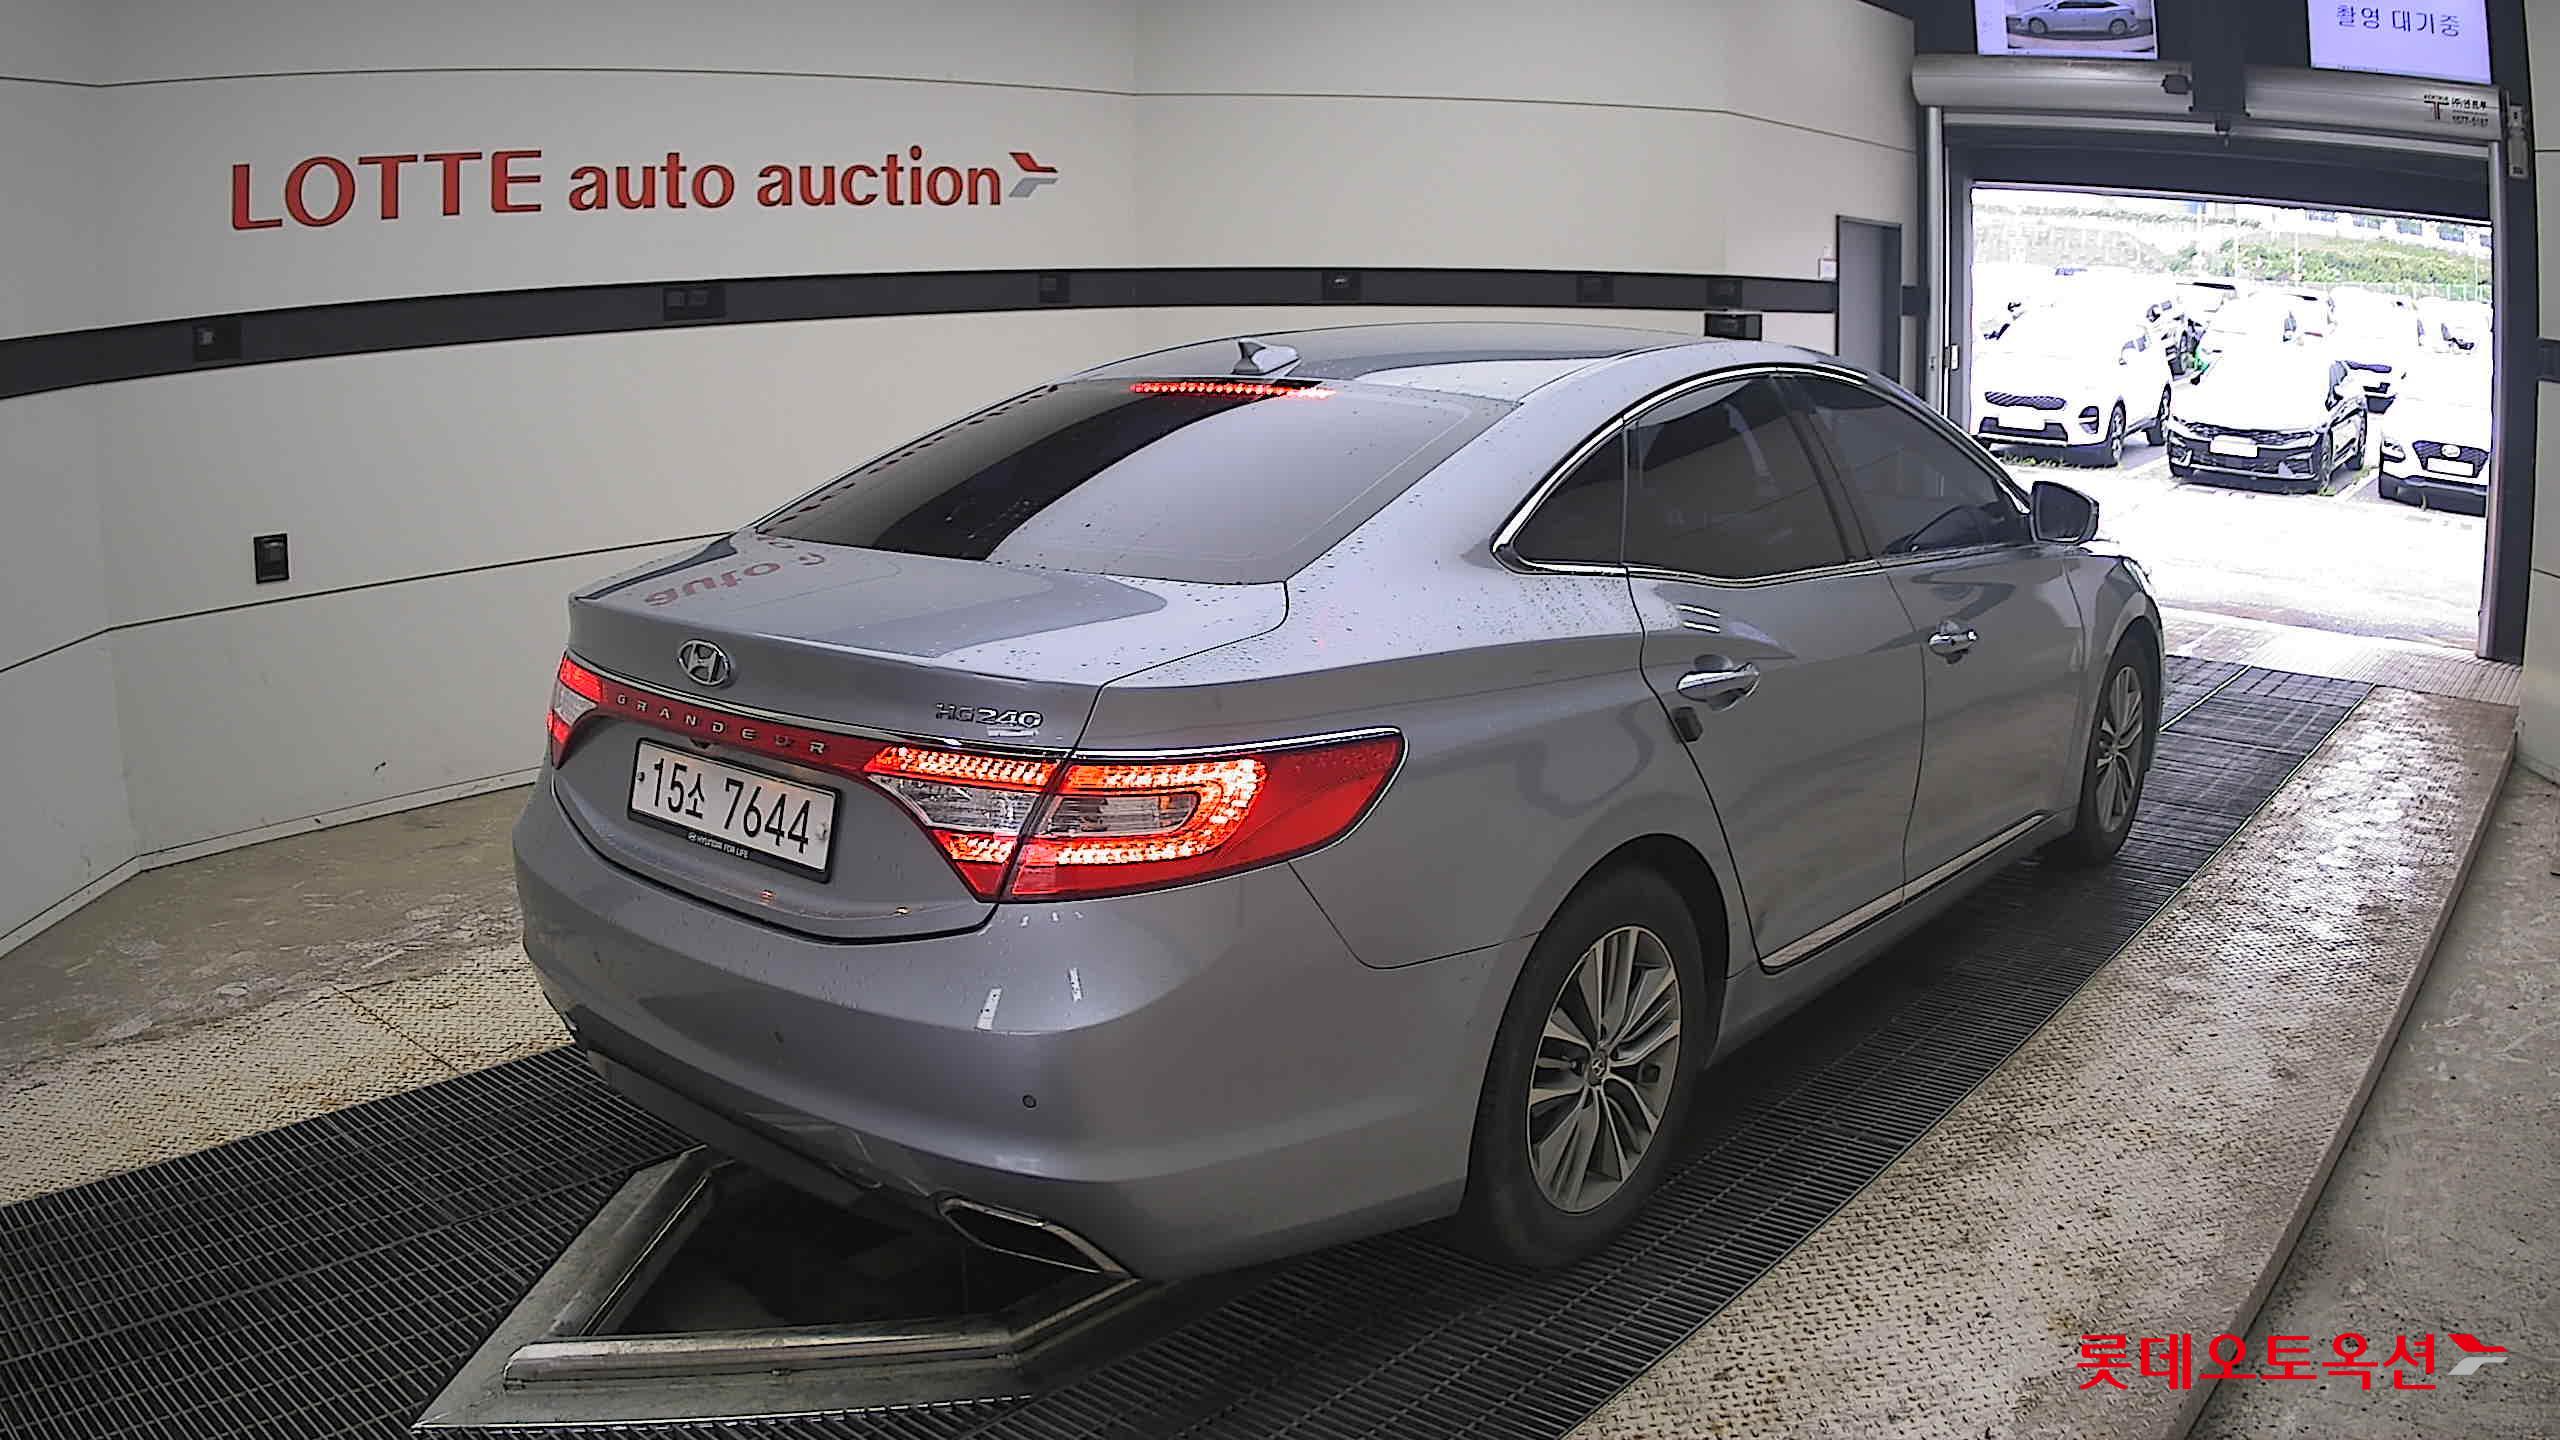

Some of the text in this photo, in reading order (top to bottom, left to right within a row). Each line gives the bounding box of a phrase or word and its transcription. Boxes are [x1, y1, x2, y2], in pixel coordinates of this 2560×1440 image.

[2337, 4, 2460, 37] 촬영 대기중
[231, 145, 1002, 231] LOTTE auto auction
[616, 693, 826, 755] GRANDEUR
[935, 702, 1043, 729] HG240
[653, 757, 812, 855] 15소 7644
